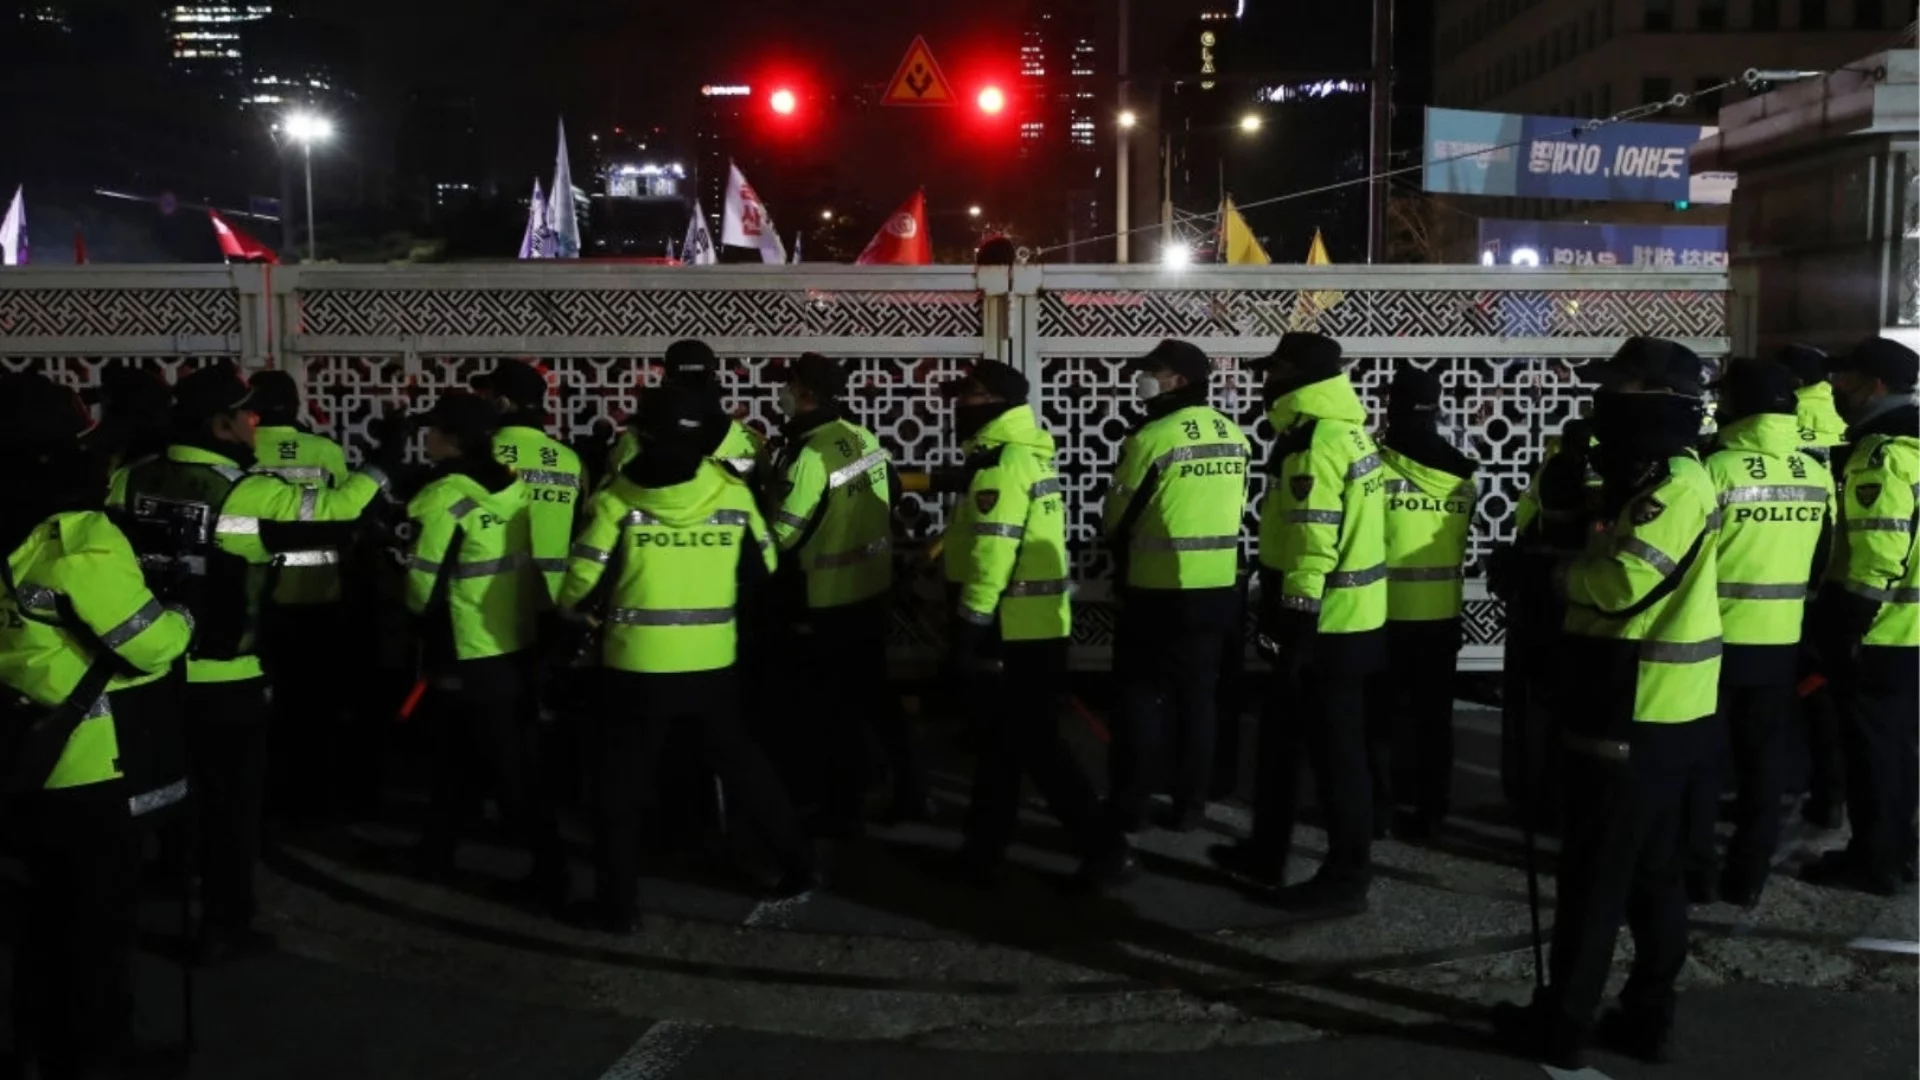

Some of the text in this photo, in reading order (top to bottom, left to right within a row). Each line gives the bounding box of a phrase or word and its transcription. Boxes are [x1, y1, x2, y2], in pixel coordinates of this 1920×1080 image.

[1179, 461, 1243, 478] POLICE
[1389, 498, 1468, 514] POLICE
[1734, 507, 1821, 522] POLICE
[634, 532, 733, 548] POLICE
